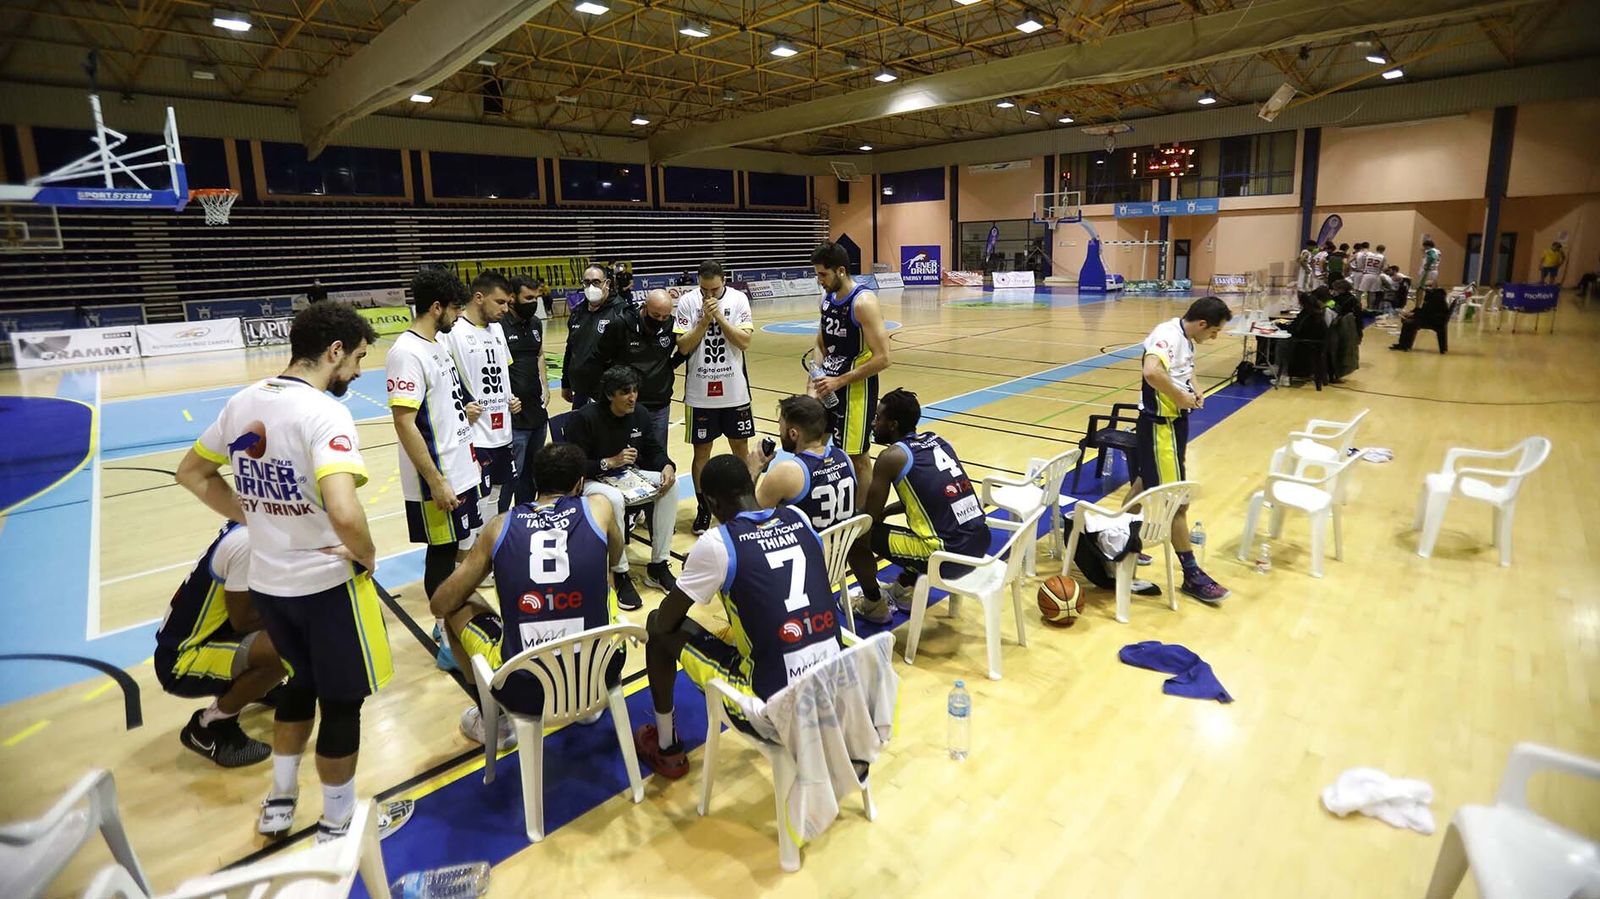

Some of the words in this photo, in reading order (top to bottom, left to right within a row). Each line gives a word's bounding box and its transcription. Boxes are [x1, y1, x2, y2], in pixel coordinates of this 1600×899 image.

[78, 191, 112, 201] SPORT
[113, 193, 152, 201] SYSTEM
[911, 267, 938, 275] DRINK
[915, 261, 938, 269] ENER
[1366, 259, 1380, 267] 22
[546, 265, 566, 286] DEL
[707, 321, 722, 337] 33
[826, 317, 841, 337] 22
[485, 348, 496, 364] 11
[716, 365, 732, 373] asset
[397, 377, 415, 391] ice
[737, 420, 752, 431] 33
[238, 456, 297, 485] ENER
[932, 445, 964, 478] 4
[234, 474, 303, 502] DRINK
[262, 501, 315, 516] DRINK
[811, 476, 855, 528] 30
[739, 521, 804, 542] master.house
[758, 532, 799, 552] THIAM
[529, 528, 571, 585] 8
[764, 544, 811, 613] 7
[545, 588, 582, 612] ice
[803, 610, 836, 636] ice
